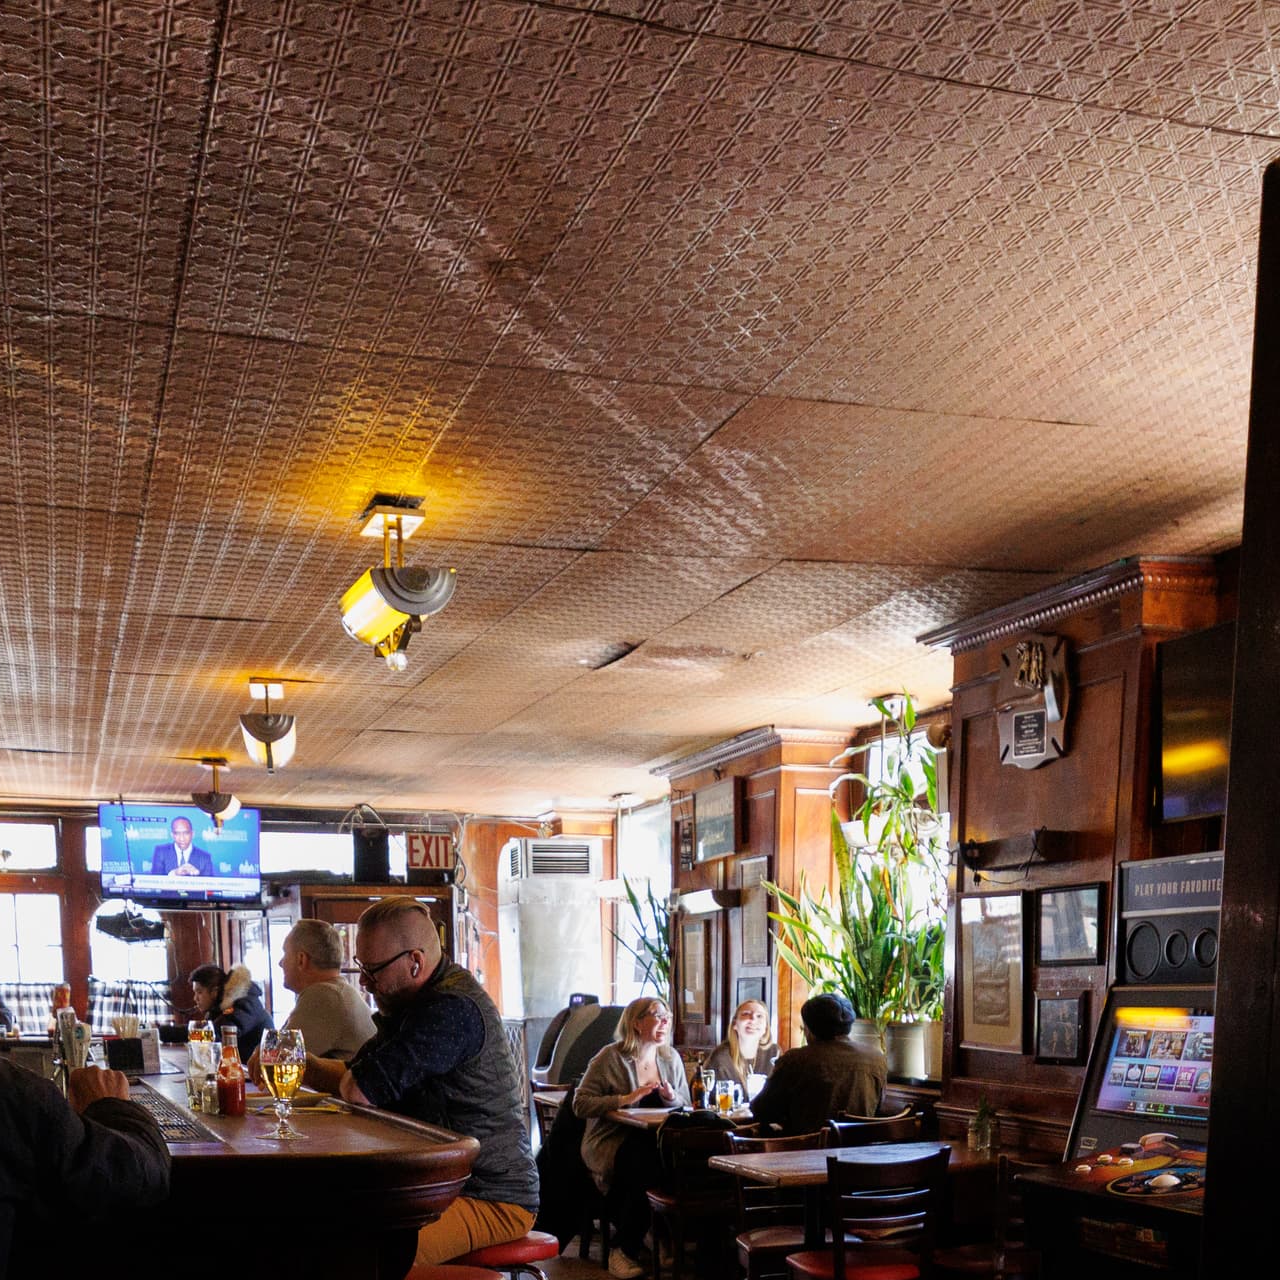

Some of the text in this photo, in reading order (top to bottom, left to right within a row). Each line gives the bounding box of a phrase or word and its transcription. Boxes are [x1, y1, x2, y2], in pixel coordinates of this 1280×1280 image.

[408, 835, 451, 867] EXIT
[1134, 878, 1221, 897] PLAY YOUR FAVORITE
